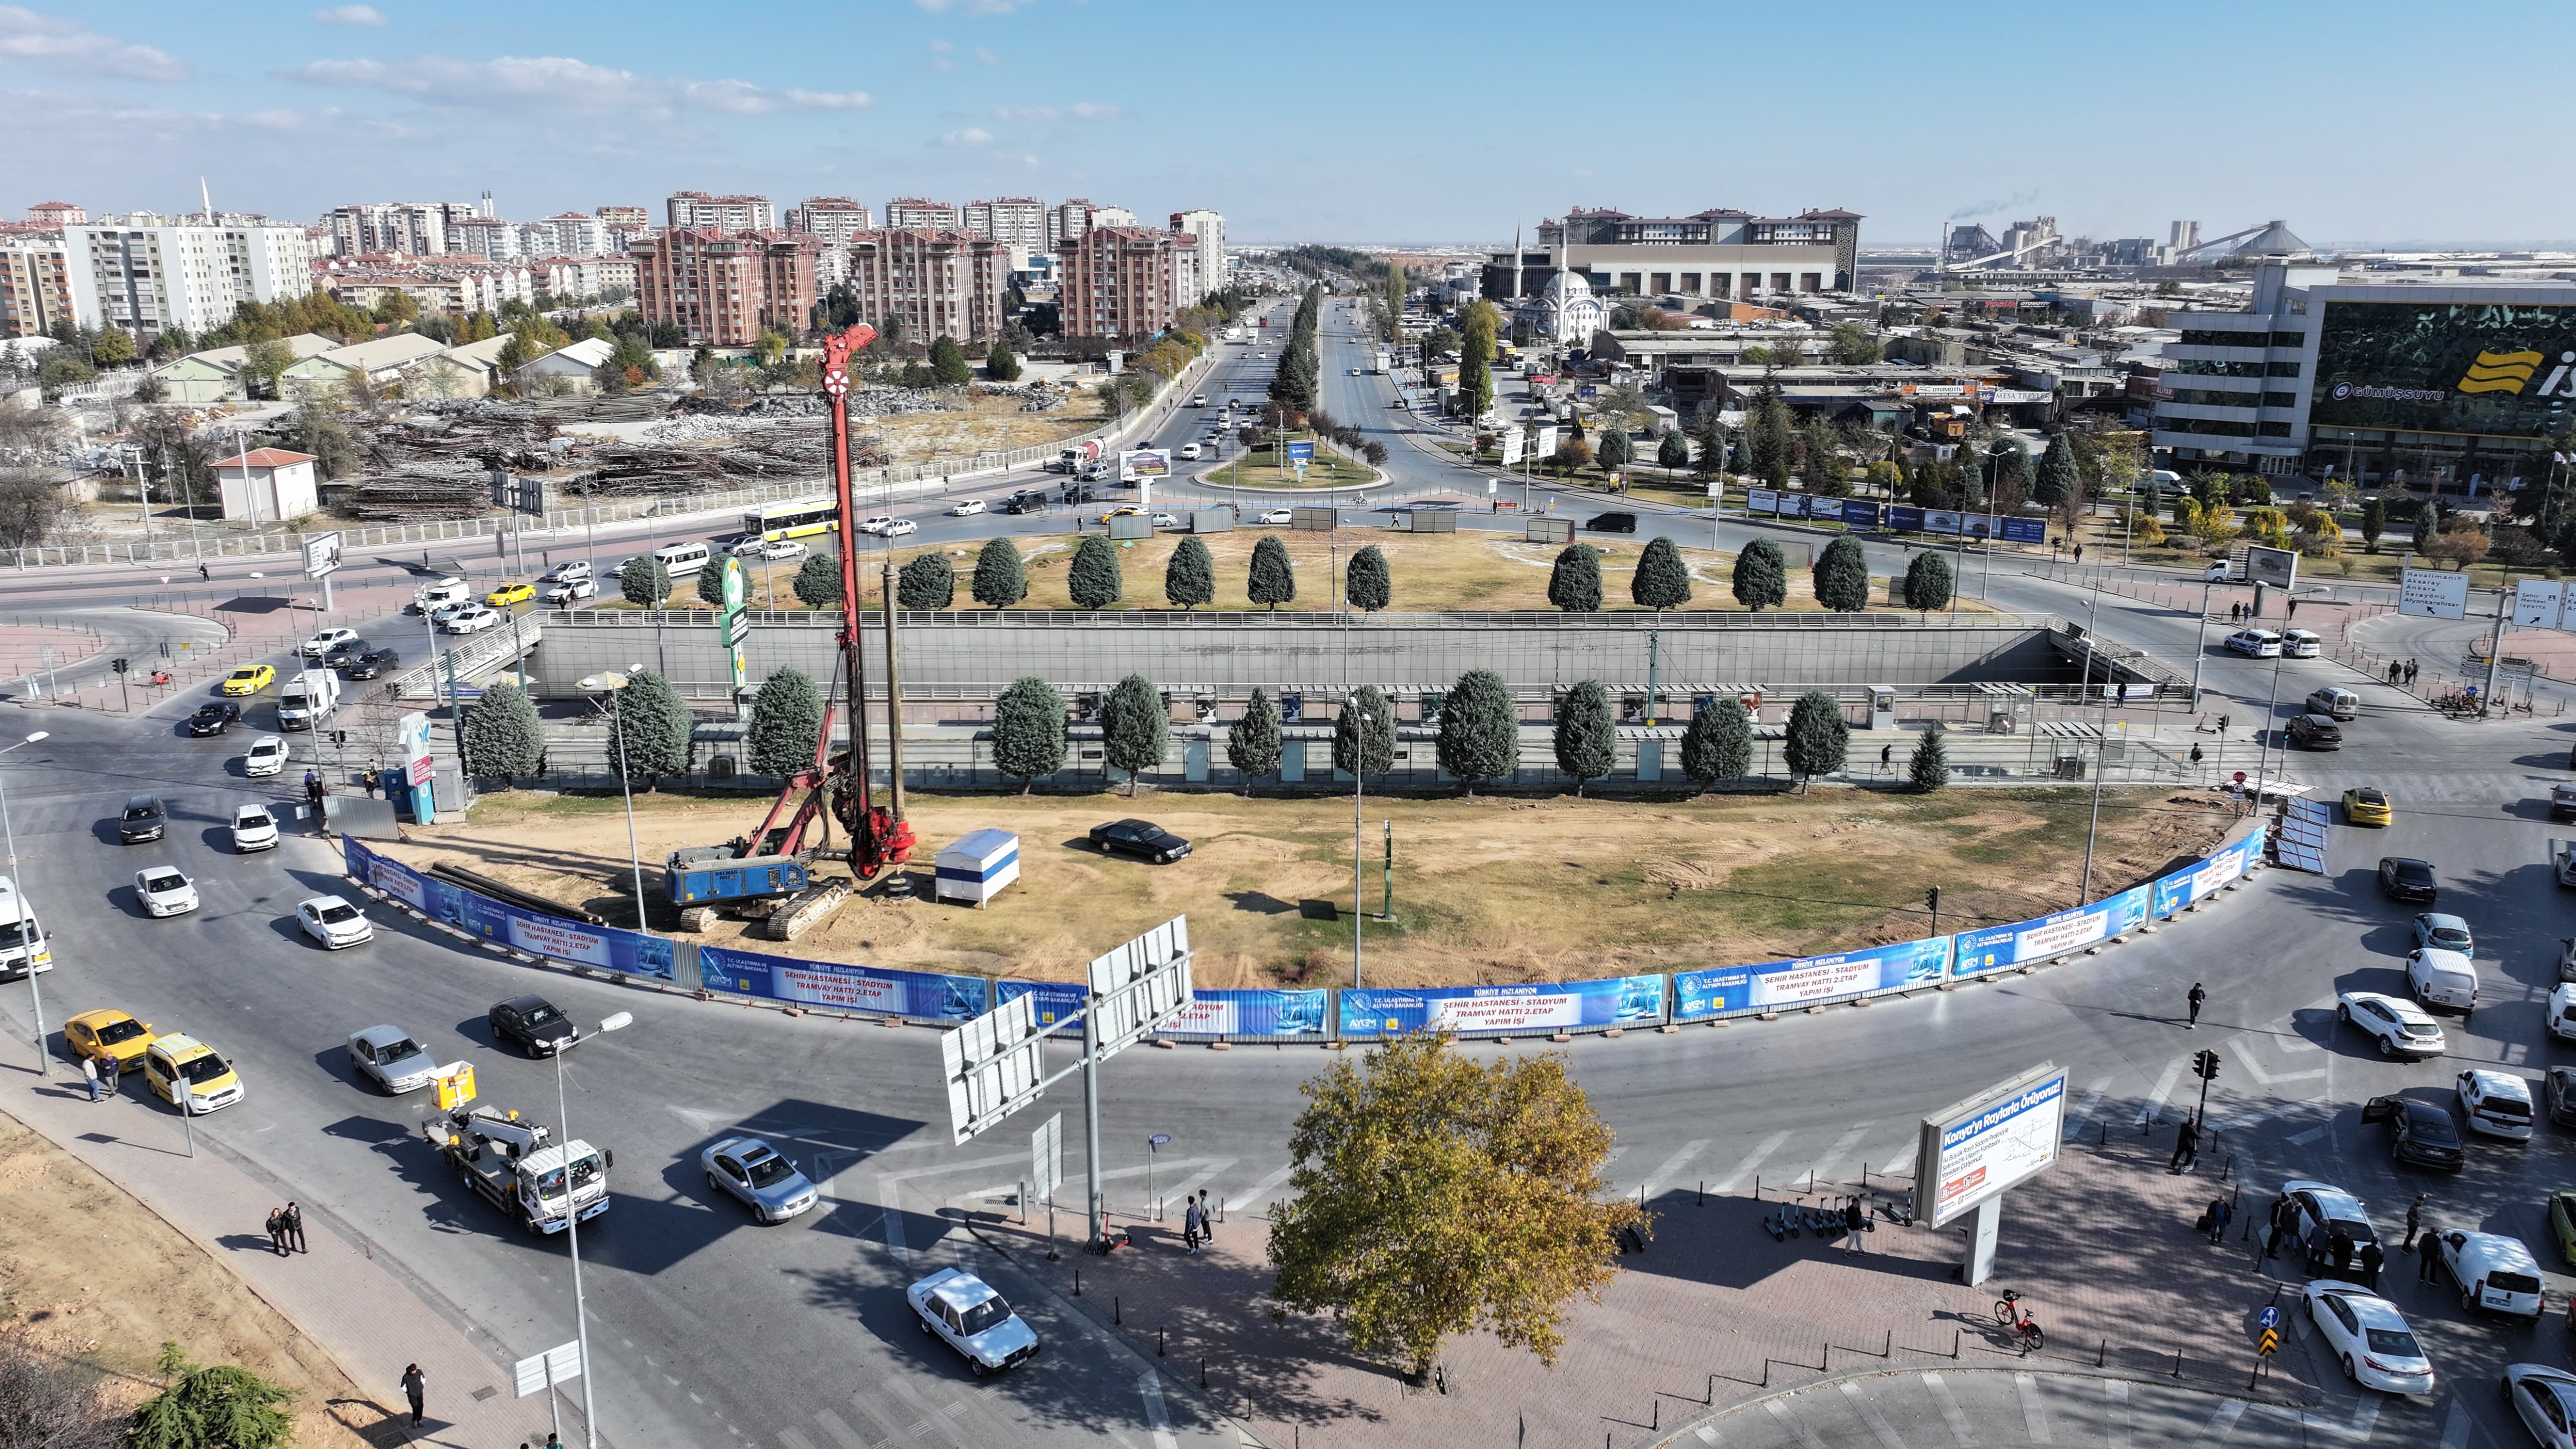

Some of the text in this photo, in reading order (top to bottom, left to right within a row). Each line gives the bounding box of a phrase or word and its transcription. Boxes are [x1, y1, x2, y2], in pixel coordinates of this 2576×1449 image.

[2352, 385, 2445, 401] GÜMÜŞSUYU
[2407, 579, 2441, 587] Aksaray
[2404, 597, 2459, 607] Afyonkarahisar
[2405, 591, 2445, 599] Sarayönü
[532, 915, 576, 930] TÜRKİYE HIZLANIYOR
[2027, 931, 2043, 941] ŞEHİR
[2044, 923, 2073, 937] HASTANESİ
[2076, 915, 2101, 927] STADYUM
[516, 920, 531, 930] ŞEHİR
[532, 925, 565, 937] HASTANESİ
[569, 933, 598, 944] STADYUM
[2034, 926, 2092, 946] TRAMVAY HATTI 2.ETAP
[524, 932, 591, 950] TRAMVAY HATTI 2.ETAP
[2051, 941, 2067, 950] YAPIM
[543, 944, 561, 954] YAPIM
[809, 963, 865, 975] TÜRKİYE HIZLANIYOR
[1791, 956, 1845, 971] TÜRKİYE HIZLANIYOR
[785, 971, 806, 980] ŞEHİR
[809, 974, 850, 985] HASTANESİ
[856, 980, 893, 990] STADYUM
[1713, 975, 1739, 983] ULAŞTIRMA
[1764, 974, 1787, 985] ŞEHİR
[1789, 967, 1830, 981] HASTANESİ
[1835, 963, 1869, 974] STADYUM
[796, 982, 832, 991] TRAMVAY
[856, 989, 882, 997] 2.ETAP
[1721, 979, 1747, 987] BAKANLIĞI
[1776, 974, 1858, 991] TRAMVAY HATTI 2.ETAP
[1474, 987, 1538, 997] TÜRKİYE HIZLANIYOR
[1800, 986, 1834, 997] YAPIM İŞİ
[822, 994, 857, 1005] YAPIM İŞİ
[1443, 999, 1470, 1009] ŞEHİR
[1472, 998, 1520, 1007] HASTANESİ
[1526, 997, 1567, 1006] STADYUM
[1456, 1009, 1497, 1017] TRAMVAY
[1485, 1016, 1525, 1026] YAPIM İŞİ
[1944, 1080, 2061, 1147] Konya'yı Raylarla Örüyoruz!
[1949, 1150, 1963, 1161] Büyük
[1963, 1144, 1974, 1154] Raylı
[1974, 1137, 1989, 1149] Sistem
[1989, 1127, 2009, 1141] Projesiyle
[1980, 1139, 2000, 1153] Haritasını
[1942, 1166, 1960, 1179] Yeniden
[1961, 1153, 1983, 1168] Çiziyoruz!
